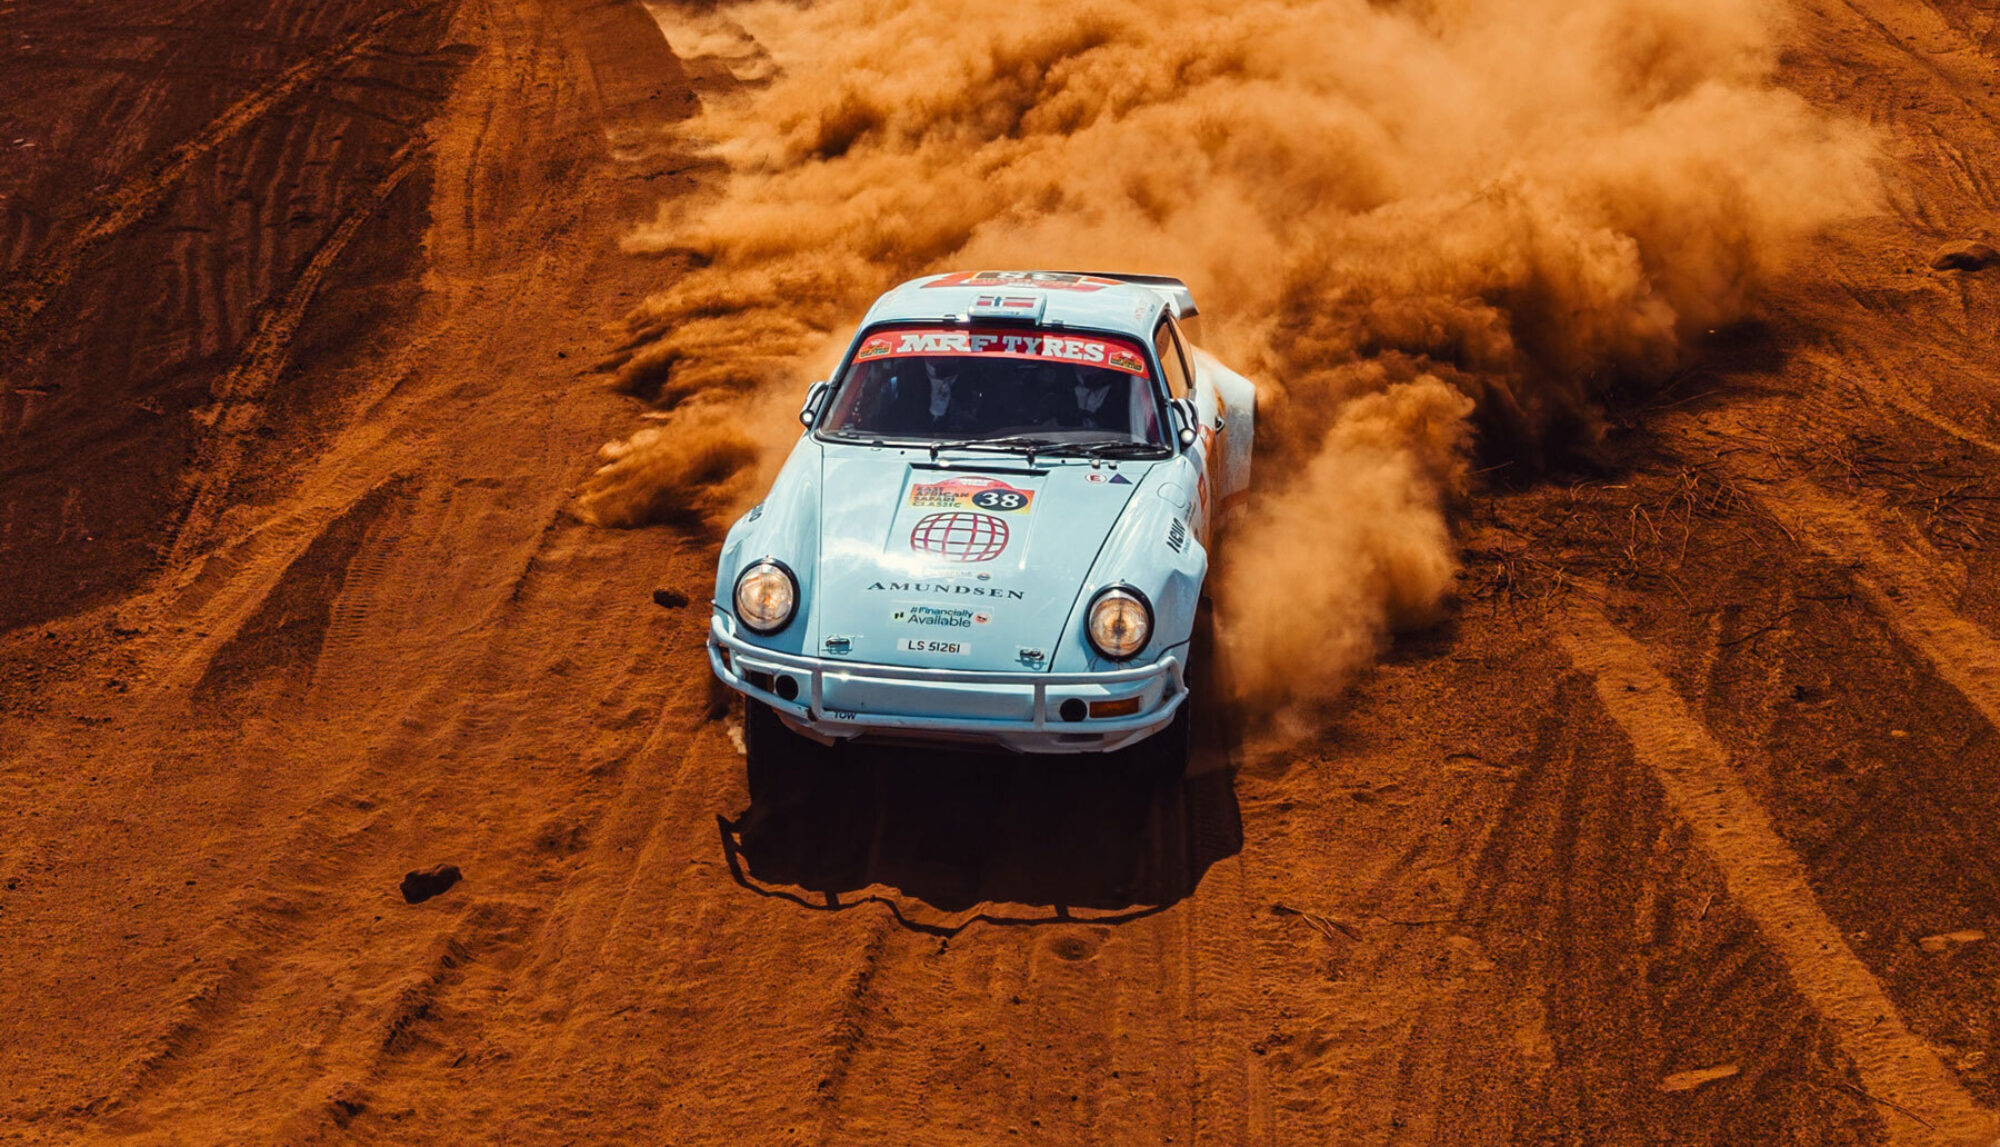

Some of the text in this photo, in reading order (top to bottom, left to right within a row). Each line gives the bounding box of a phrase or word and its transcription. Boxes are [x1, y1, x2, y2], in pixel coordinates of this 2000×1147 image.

[896, 334, 998, 353] MRF
[1002, 335, 1104, 362] TYRES
[979, 492, 1020, 508] 38
[867, 581, 1025, 600] AMUNDSEN
[910, 606, 974, 619] #Financially
[907, 614, 971, 628] Available
[908, 640, 960, 653] LS 51261
